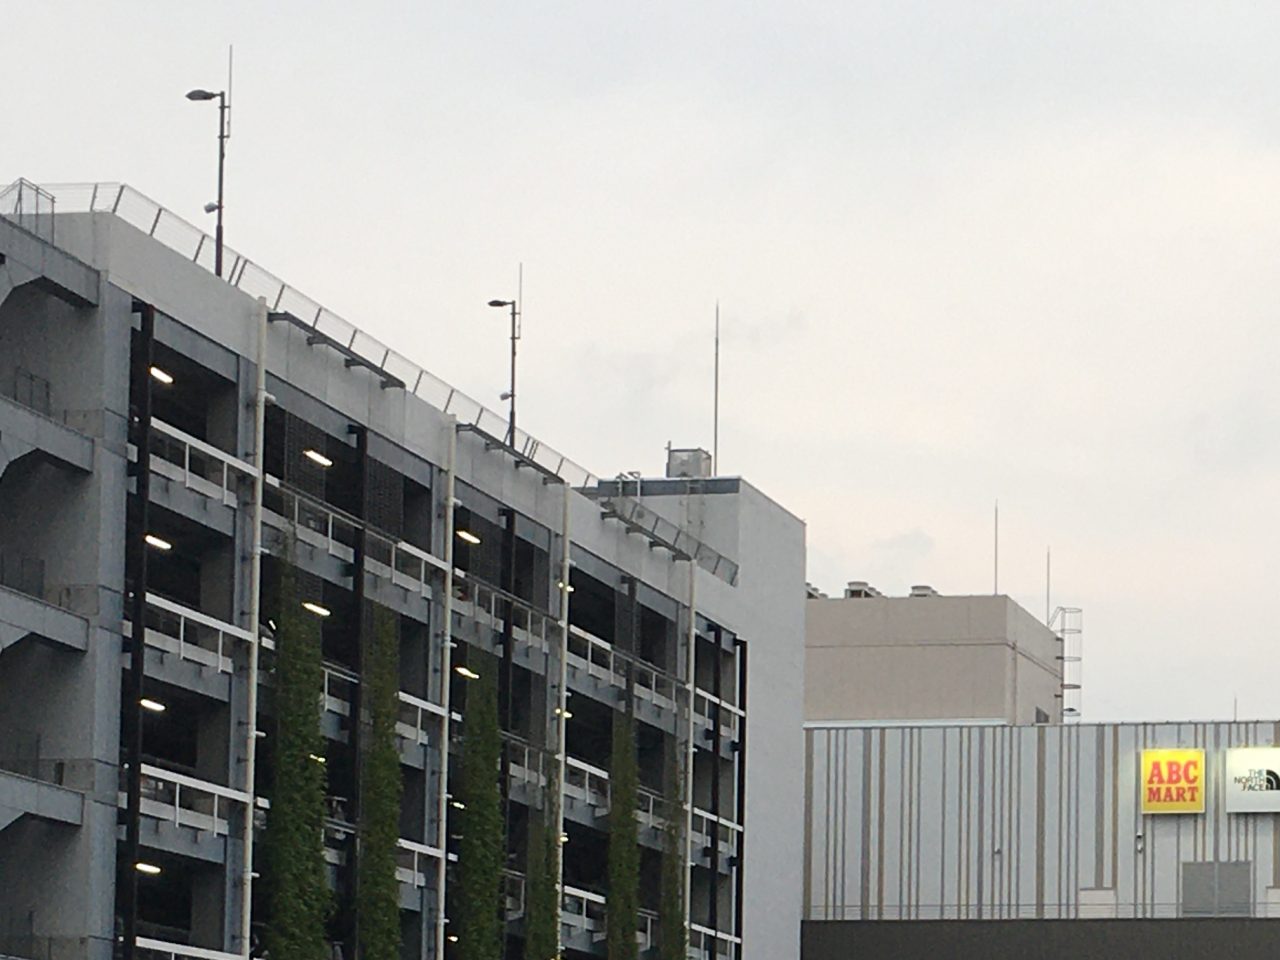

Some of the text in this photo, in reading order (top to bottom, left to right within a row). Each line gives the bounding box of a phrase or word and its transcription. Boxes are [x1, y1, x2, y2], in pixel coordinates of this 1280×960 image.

[1148, 761, 1198, 785] ABC
[1248, 769, 1265, 777] THE
[1241, 784, 1265, 792] FACE
[1148, 786, 1198, 803] MART
